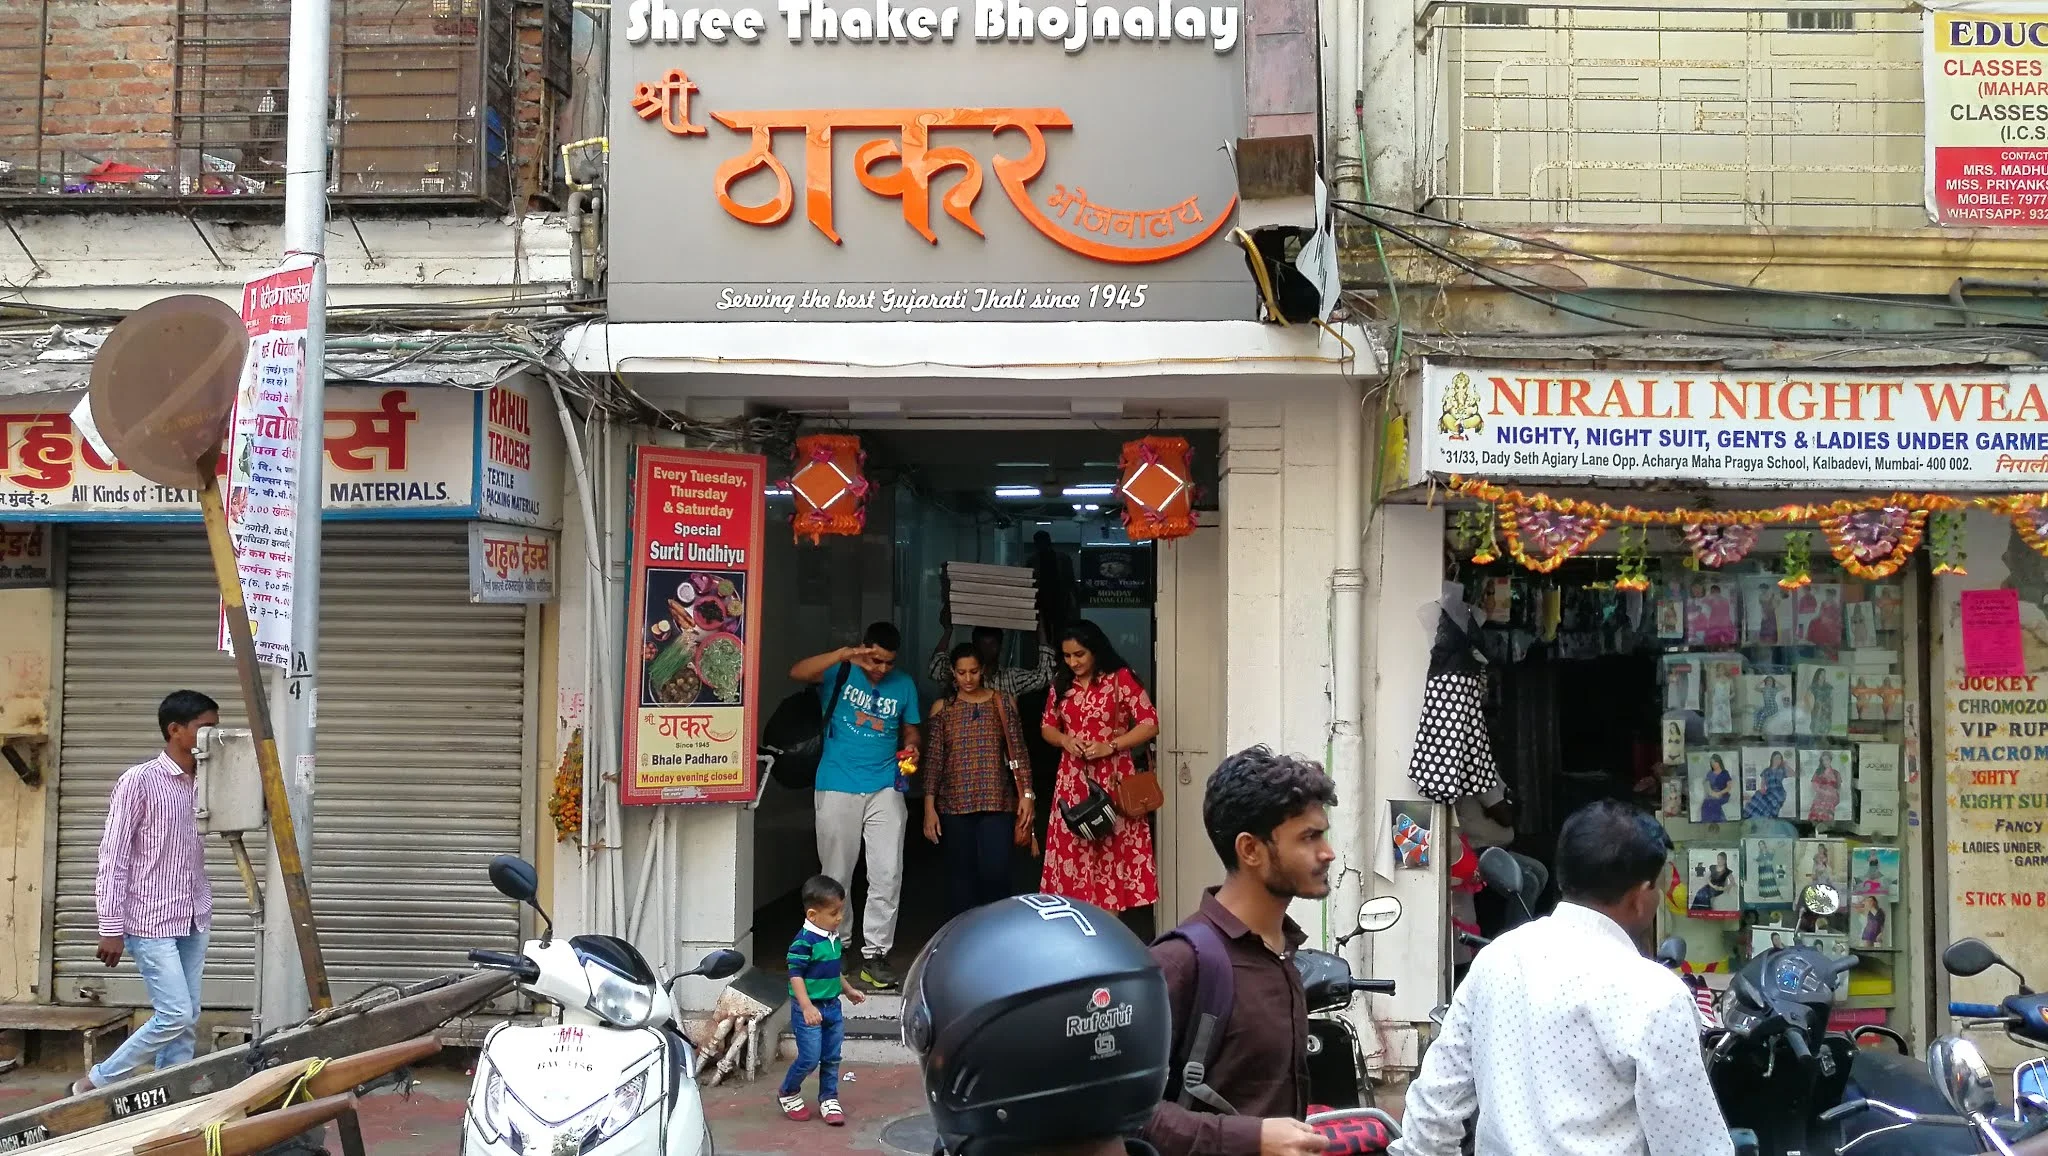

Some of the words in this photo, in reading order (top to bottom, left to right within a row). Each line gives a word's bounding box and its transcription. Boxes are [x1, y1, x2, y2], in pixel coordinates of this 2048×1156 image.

[627, 0, 766, 45] Shree
[778, 0, 961, 43] Thaker
[974, 0, 1241, 54] Bhojnalay
[1943, 59, 2043, 76] CLASSES
[1978, 81, 2048, 99] (MAHAR
[1950, 104, 2048, 121] CLASSES
[630, 67, 708, 136] श्री
[708, 106, 1237, 264] ठाकर
[2001, 151, 2048, 161] CONTACT
[1963, 165, 1997, 176] MRS.
[2001, 165, 2048, 176] MADHU
[1946, 180, 1983, 191] MISS.
[1958, 194, 2014, 205] MOBILE:
[2018, 194, 2047, 205] 7977
[1047, 183, 1204, 240] भोजनालय
[1947, 208, 2026, 220] WHATSAPP:
[716, 286, 796, 313] Serving
[798, 288, 830, 309] the
[833, 287, 876, 309] best
[879, 287, 968, 314] Gujarati
[971, 287, 1028, 312] Thali
[1029, 287, 1081, 309] since
[1087, 283, 1149, 310] 1945
[1487, 376, 1695, 420] NIRALI
[1709, 379, 1904, 422] NIGHT
[489, 386, 531, 436] RAHUL
[1497, 426, 1580, 448] NIGHTY,
[1586, 427, 1652, 447] NIGHT
[1659, 429, 1710, 451] SUIT,
[1717, 430, 1787, 449] GENTS
[1794, 430, 1809, 449] &
[1816, 431, 1890, 449] LADIES
[1897, 432, 1969, 450] UNDER
[487, 431, 531, 471] TRADERS
[1445, 449, 1479, 466] 31/33,
[1481, 451, 1512, 468] Dady
[1514, 451, 1539, 466] Seth
[1541, 451, 1579, 469] Agiary
[1581, 452, 1609, 467] Lane
[1612, 453, 1639, 469] Opp.
[1641, 453, 1688, 470] Acharya
[1691, 454, 1721, 468] Maha
[1725, 455, 1763, 473] Pragya
[1766, 456, 1810, 472] School,
[1812, 456, 1872, 472] Kalbadevi,
[1875, 457, 1924, 470] Mumbai-
[1926, 457, 1947, 470] 400
[1949, 457, 1973, 470] 002.
[487, 467, 514, 490] TEXTILE
[653, 467, 688, 484] Every
[690, 469, 747, 488] Tuesday,
[72, 485, 87, 502] All
[93, 485, 129, 502] Kinds
[133, 485, 147, 502] of
[330, 481, 450, 502] MATERIALS.
[669, 484, 728, 503] Thursday
[486, 488, 511, 508] PACKING
[511, 495, 540, 517] MATERIALS
[663, 501, 674, 514] &
[676, 502, 734, 520] Saturday
[674, 521, 722, 538] Special
[483, 538, 520, 579] राहुल
[650, 540, 684, 561] Surti
[687, 542, 745, 567] Undhiyu
[1959, 675, 2039, 692] JOCKEY
[658, 714, 738, 743] ठाकर
[1960, 722, 1998, 737] VIP
[695, 741, 710, 749] 1945
[652, 753, 682, 766] Bhale
[684, 752, 728, 766] Padharo
[641, 773, 674, 784] Monday
[676, 771, 709, 783] evening
[710, 771, 738, 782] closed
[1960, 794, 2016, 809] NIGHT
[1995, 819, 2043, 834] FANCY
[1962, 842, 2000, 854] LADIES
[1965, 891, 2007, 906] STICK
[2011, 891, 2032, 907] NO
[1066, 1004, 1133, 1037] Ruf&Tuf
[114, 1097, 131, 1116] HC
[134, 1087, 168, 1110] 1971
